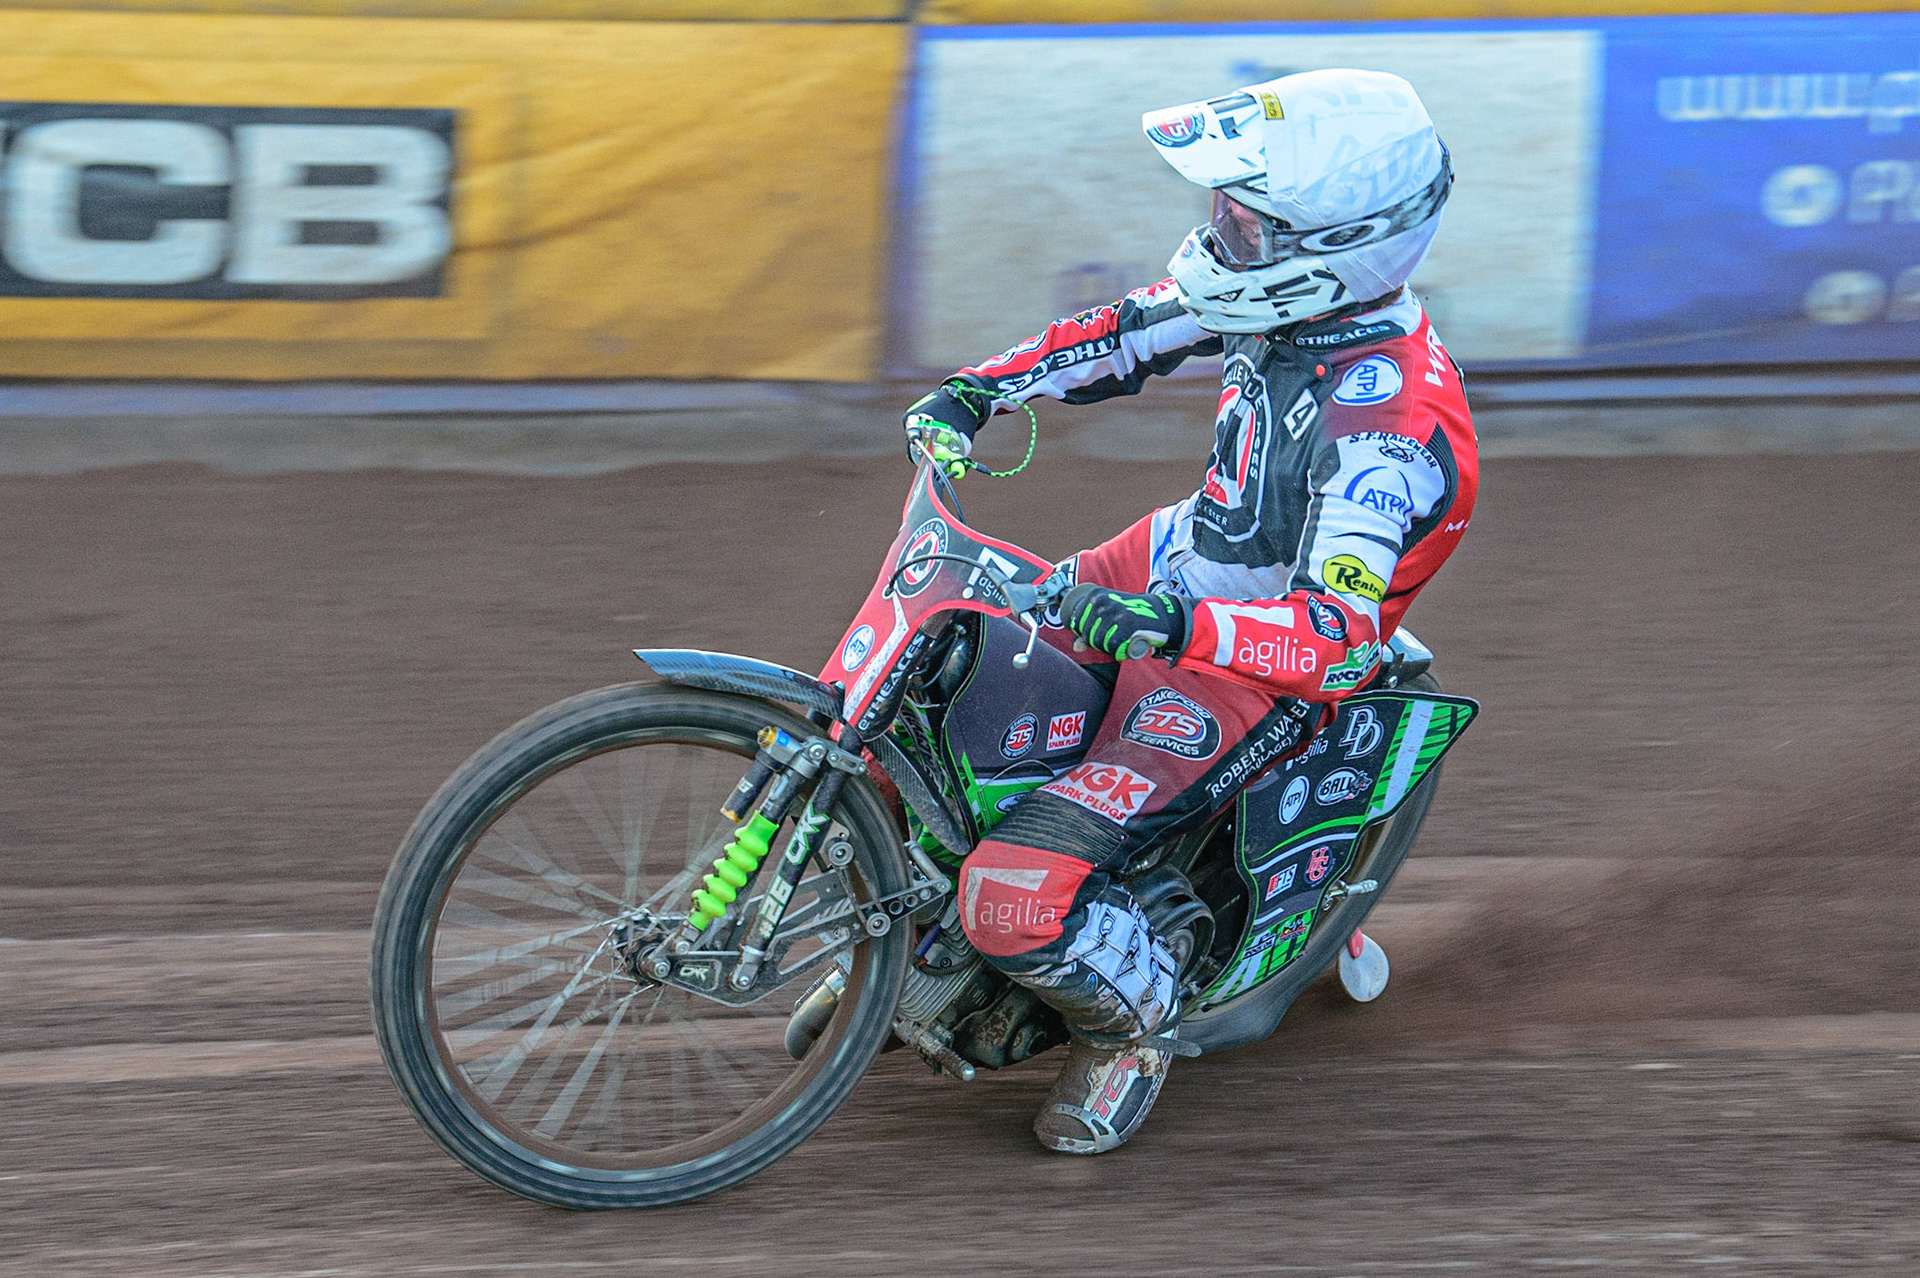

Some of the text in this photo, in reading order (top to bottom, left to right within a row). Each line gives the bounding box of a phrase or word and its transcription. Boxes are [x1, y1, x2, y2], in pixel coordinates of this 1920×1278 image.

[0, 117, 451, 284] CB
[1291, 401, 1314, 434] 4
[1238, 635, 1318, 676] agilia
[1007, 727, 1033, 745] STS
[1049, 714, 1084, 740] NGK
[1136, 709, 1203, 736] STS
[1140, 732, 1200, 756] SERVICES
[1295, 739, 1329, 764] gilia
[1210, 738, 1266, 798] ROBERT
[1069, 764, 1149, 811] NGK
[1083, 794, 1128, 821] PLUGS
[979, 897, 1056, 934] agilia
